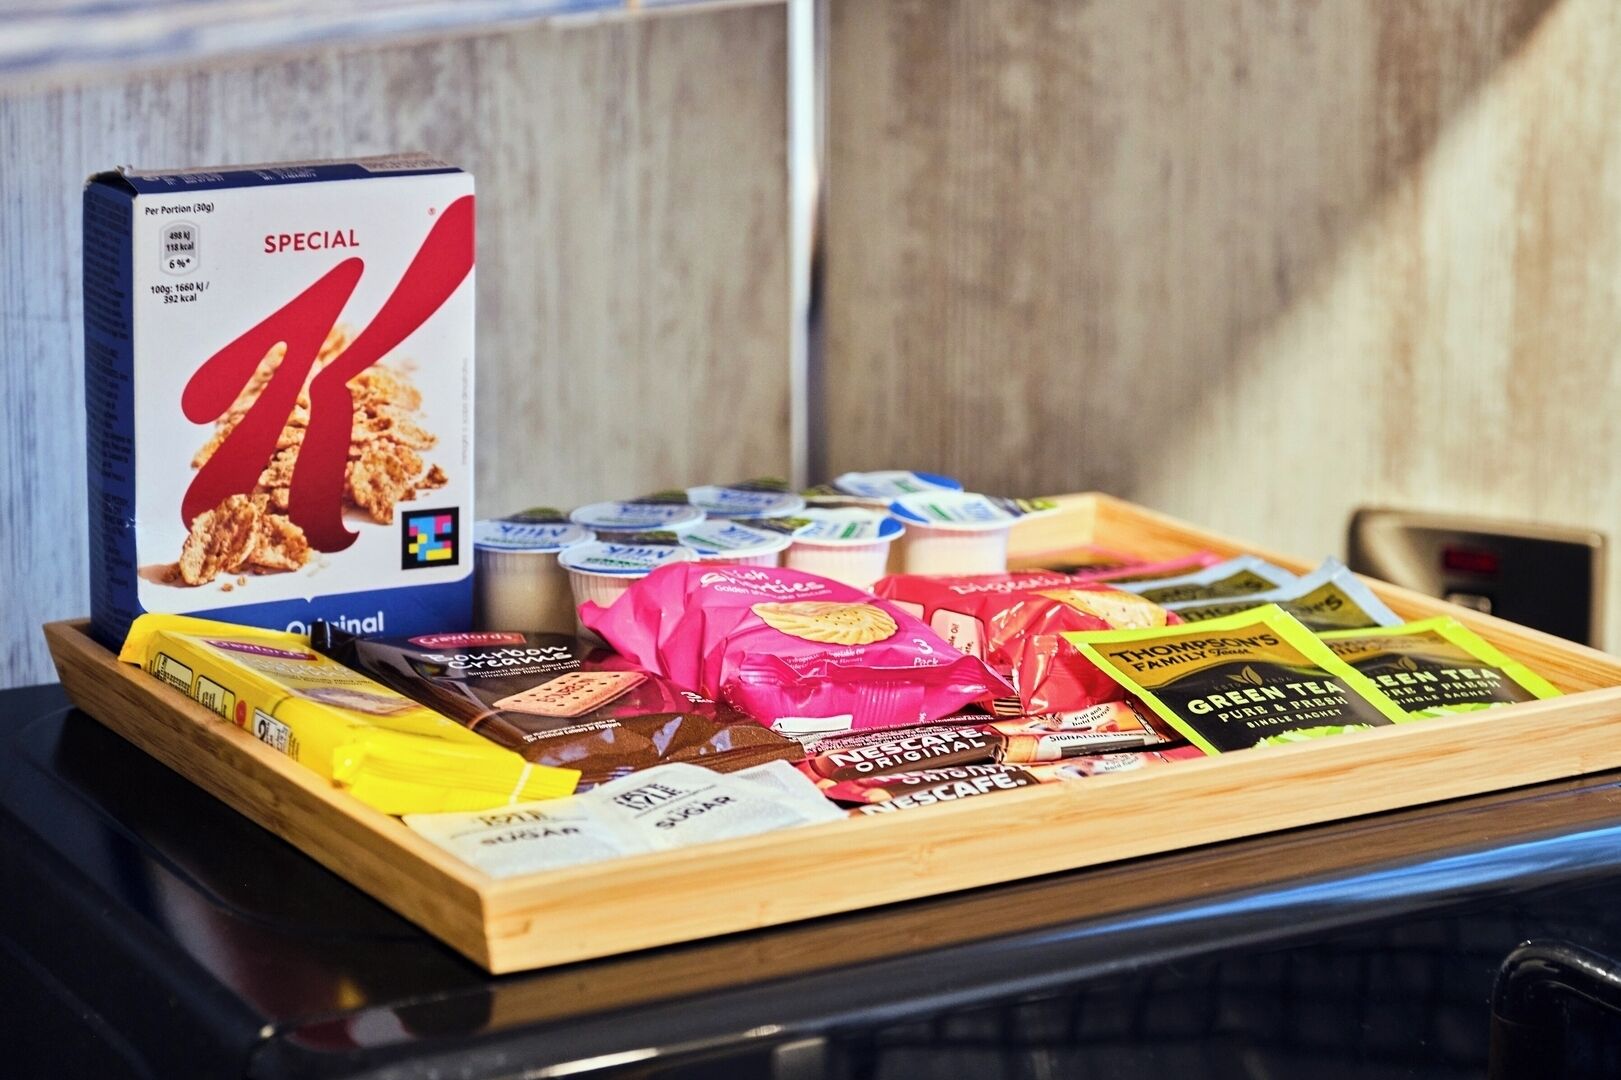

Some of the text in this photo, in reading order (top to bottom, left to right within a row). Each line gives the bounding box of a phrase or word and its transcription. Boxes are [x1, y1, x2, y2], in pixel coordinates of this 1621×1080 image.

[145, 203, 215, 215] Per Portion (30g)
[169, 232, 182, 240] 498
[264, 229, 360, 254] SPECIAL
[179, 242, 194, 251] kcal
[169, 260, 175, 269] 6
[150, 285, 173, 295] 100g:
[175, 283, 195, 292] 1660
[163, 293, 197, 304] 392 kcal
[421, 646, 568, 662] Bourbon
[912, 638, 934, 655] 3
[1109, 634, 1280, 663] THOMPSON'S
[449, 652, 572, 670] Creams
[914, 656, 939, 667] Pack
[1131, 650, 1207, 673] FAMILY
[1367, 667, 1502, 689] REEN TEA
[1441, 680, 1502, 691] FRESH
[1187, 679, 1347, 716] GREEN TEA
[1217, 695, 1350, 724] PURE & FRESH
[1246, 708, 1343, 729] SINGLE SACHET
[855, 739, 987, 773] ORIGINAL
[655, 795, 733, 830] SUGAR
[480, 826, 581, 845] SUGAR
